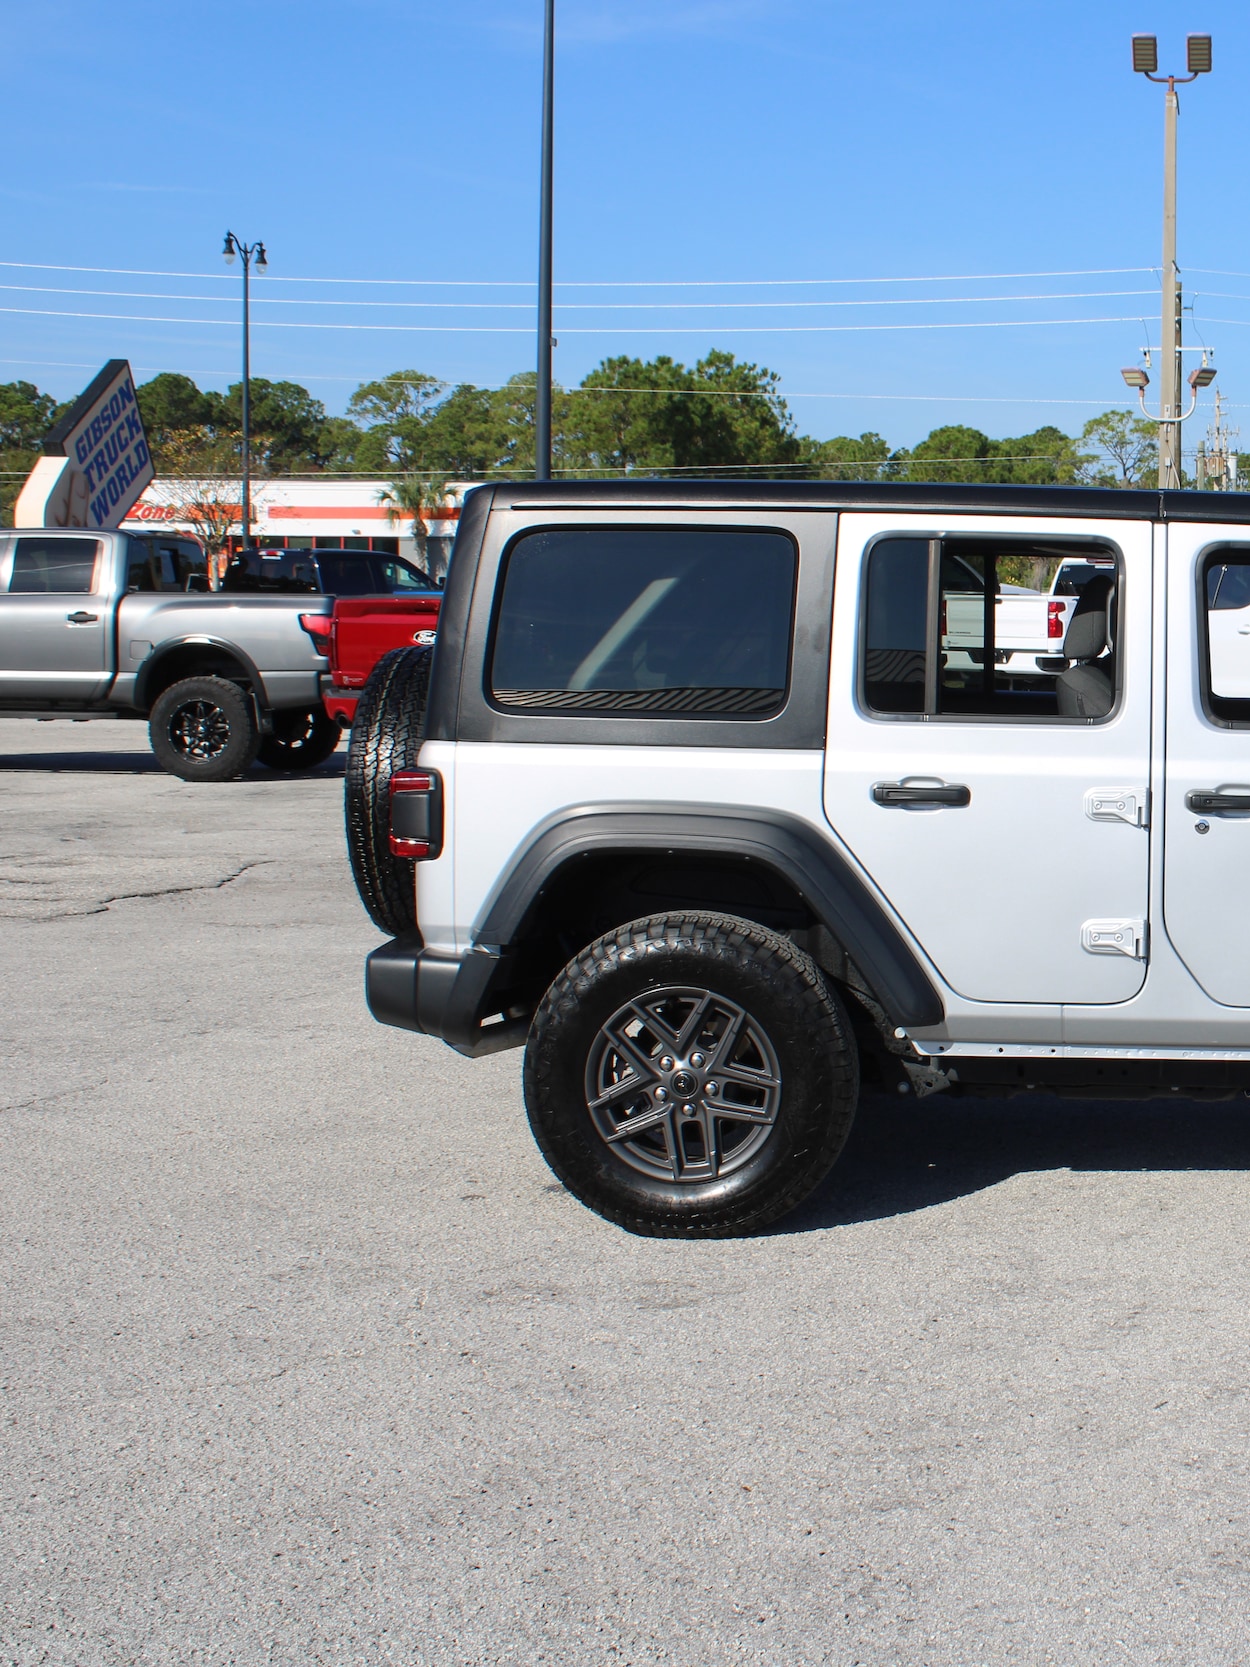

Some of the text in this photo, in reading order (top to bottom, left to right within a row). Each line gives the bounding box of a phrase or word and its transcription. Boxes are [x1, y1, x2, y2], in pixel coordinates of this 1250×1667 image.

[75, 378, 134, 465] GIBSON
[83, 407, 142, 494] TRUCK
[90, 438, 149, 527] WORLD
